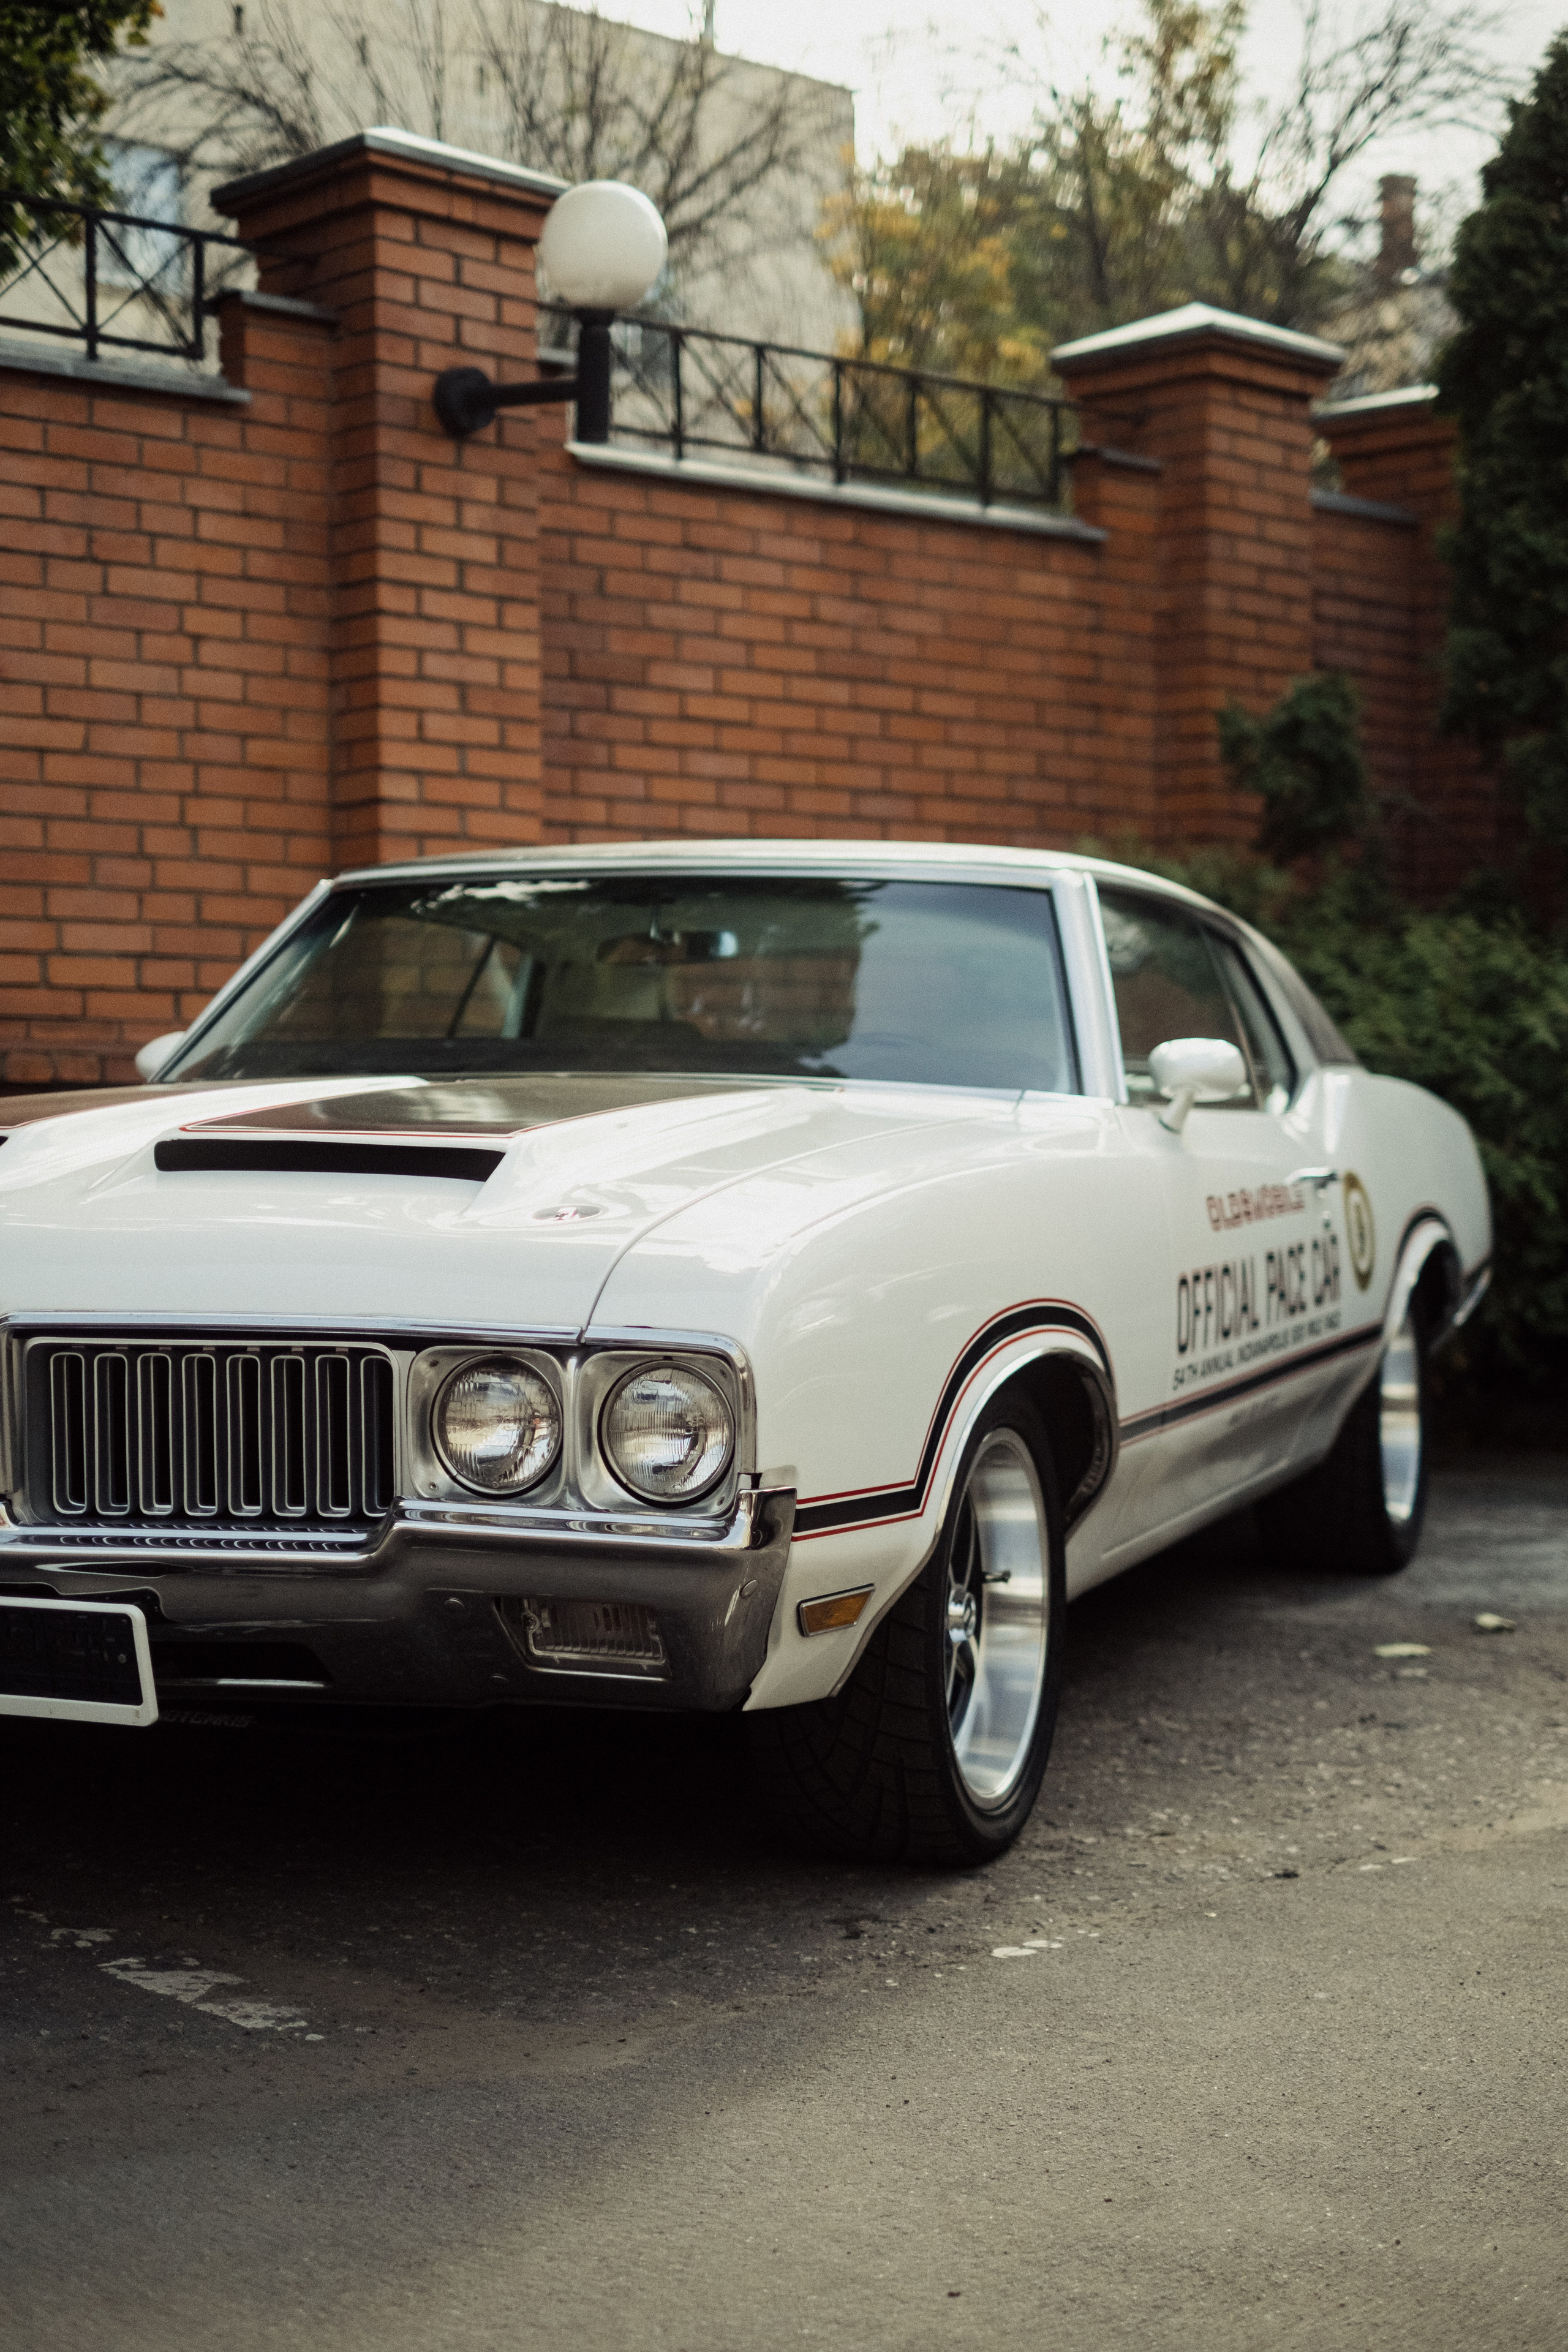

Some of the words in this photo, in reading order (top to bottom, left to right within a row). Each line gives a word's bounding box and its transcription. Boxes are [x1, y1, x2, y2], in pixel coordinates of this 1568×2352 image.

[1177, 1253, 1258, 1358] OFFICIAL
[1265, 1240, 1307, 1327] PACE
[1311, 1230, 1340, 1312] CAR
